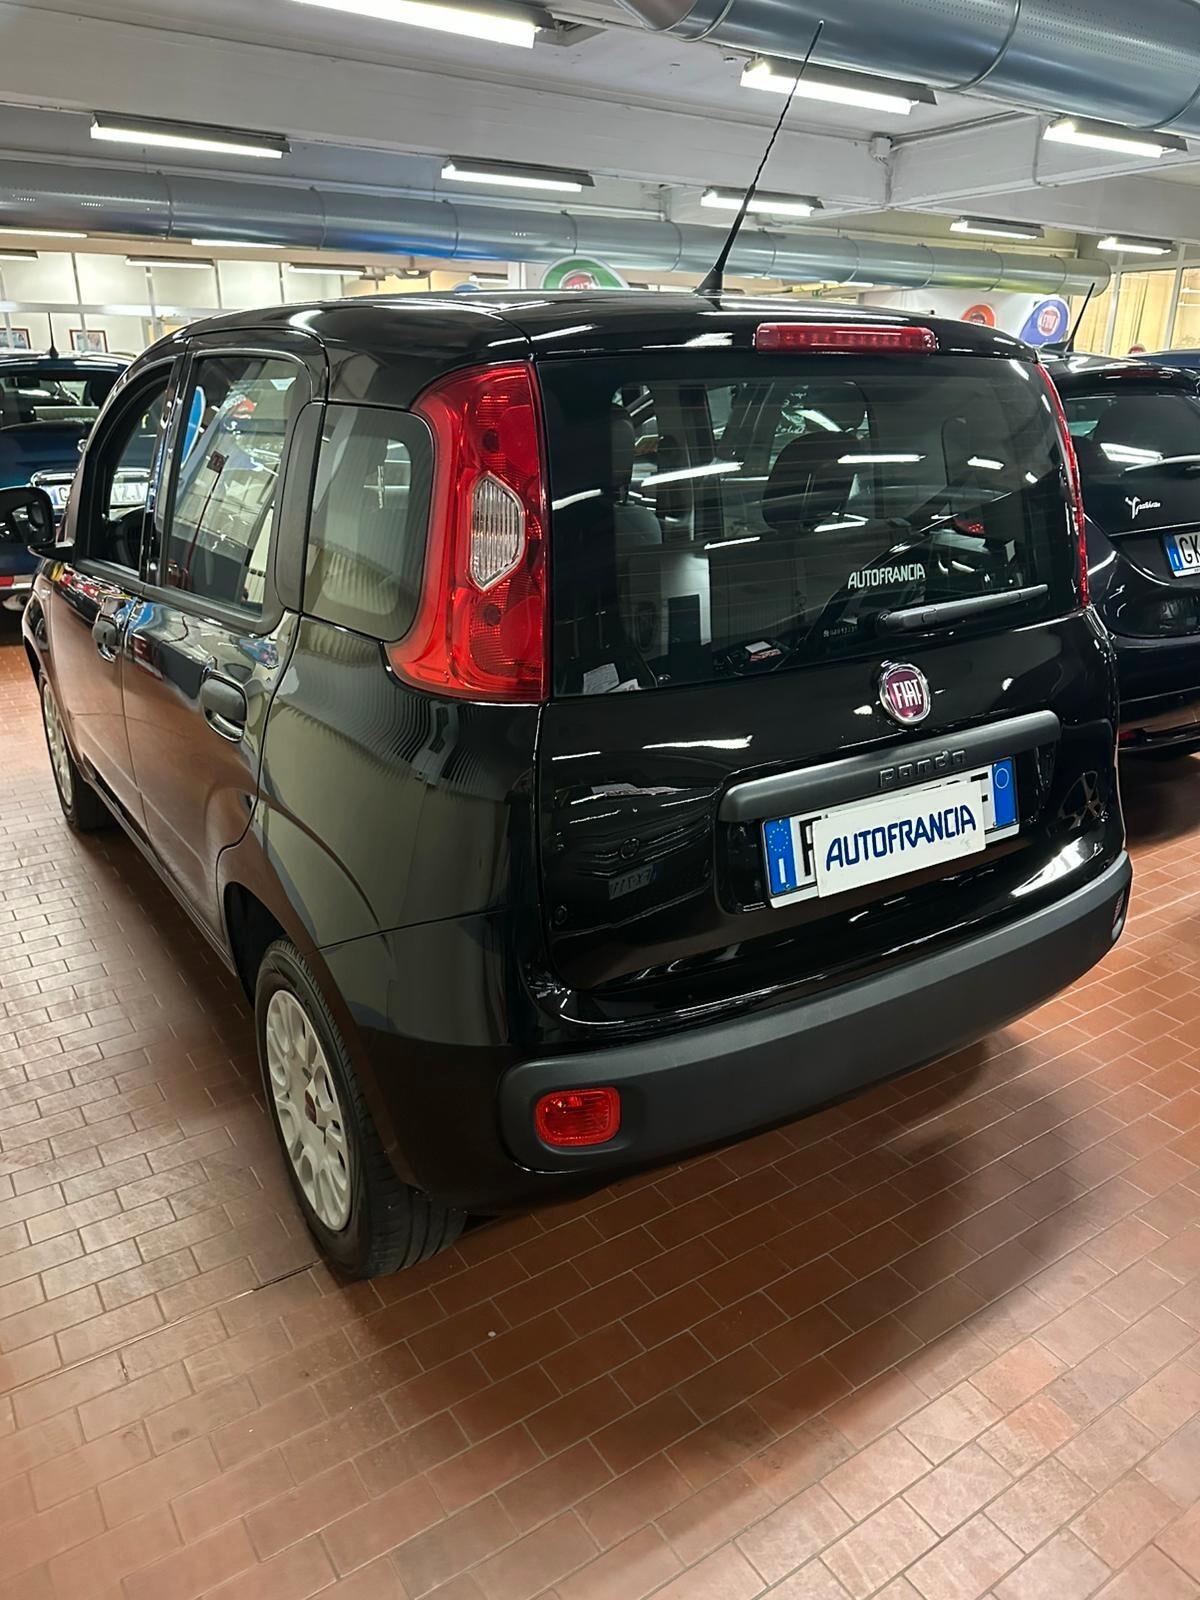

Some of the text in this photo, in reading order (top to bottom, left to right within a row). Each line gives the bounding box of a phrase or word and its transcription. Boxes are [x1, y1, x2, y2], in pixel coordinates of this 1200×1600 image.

[847, 563, 926, 590] AUTOFRANCIA
[892, 679, 922, 709] FIAT
[826, 804, 977, 872] AUTOFRANCIA
